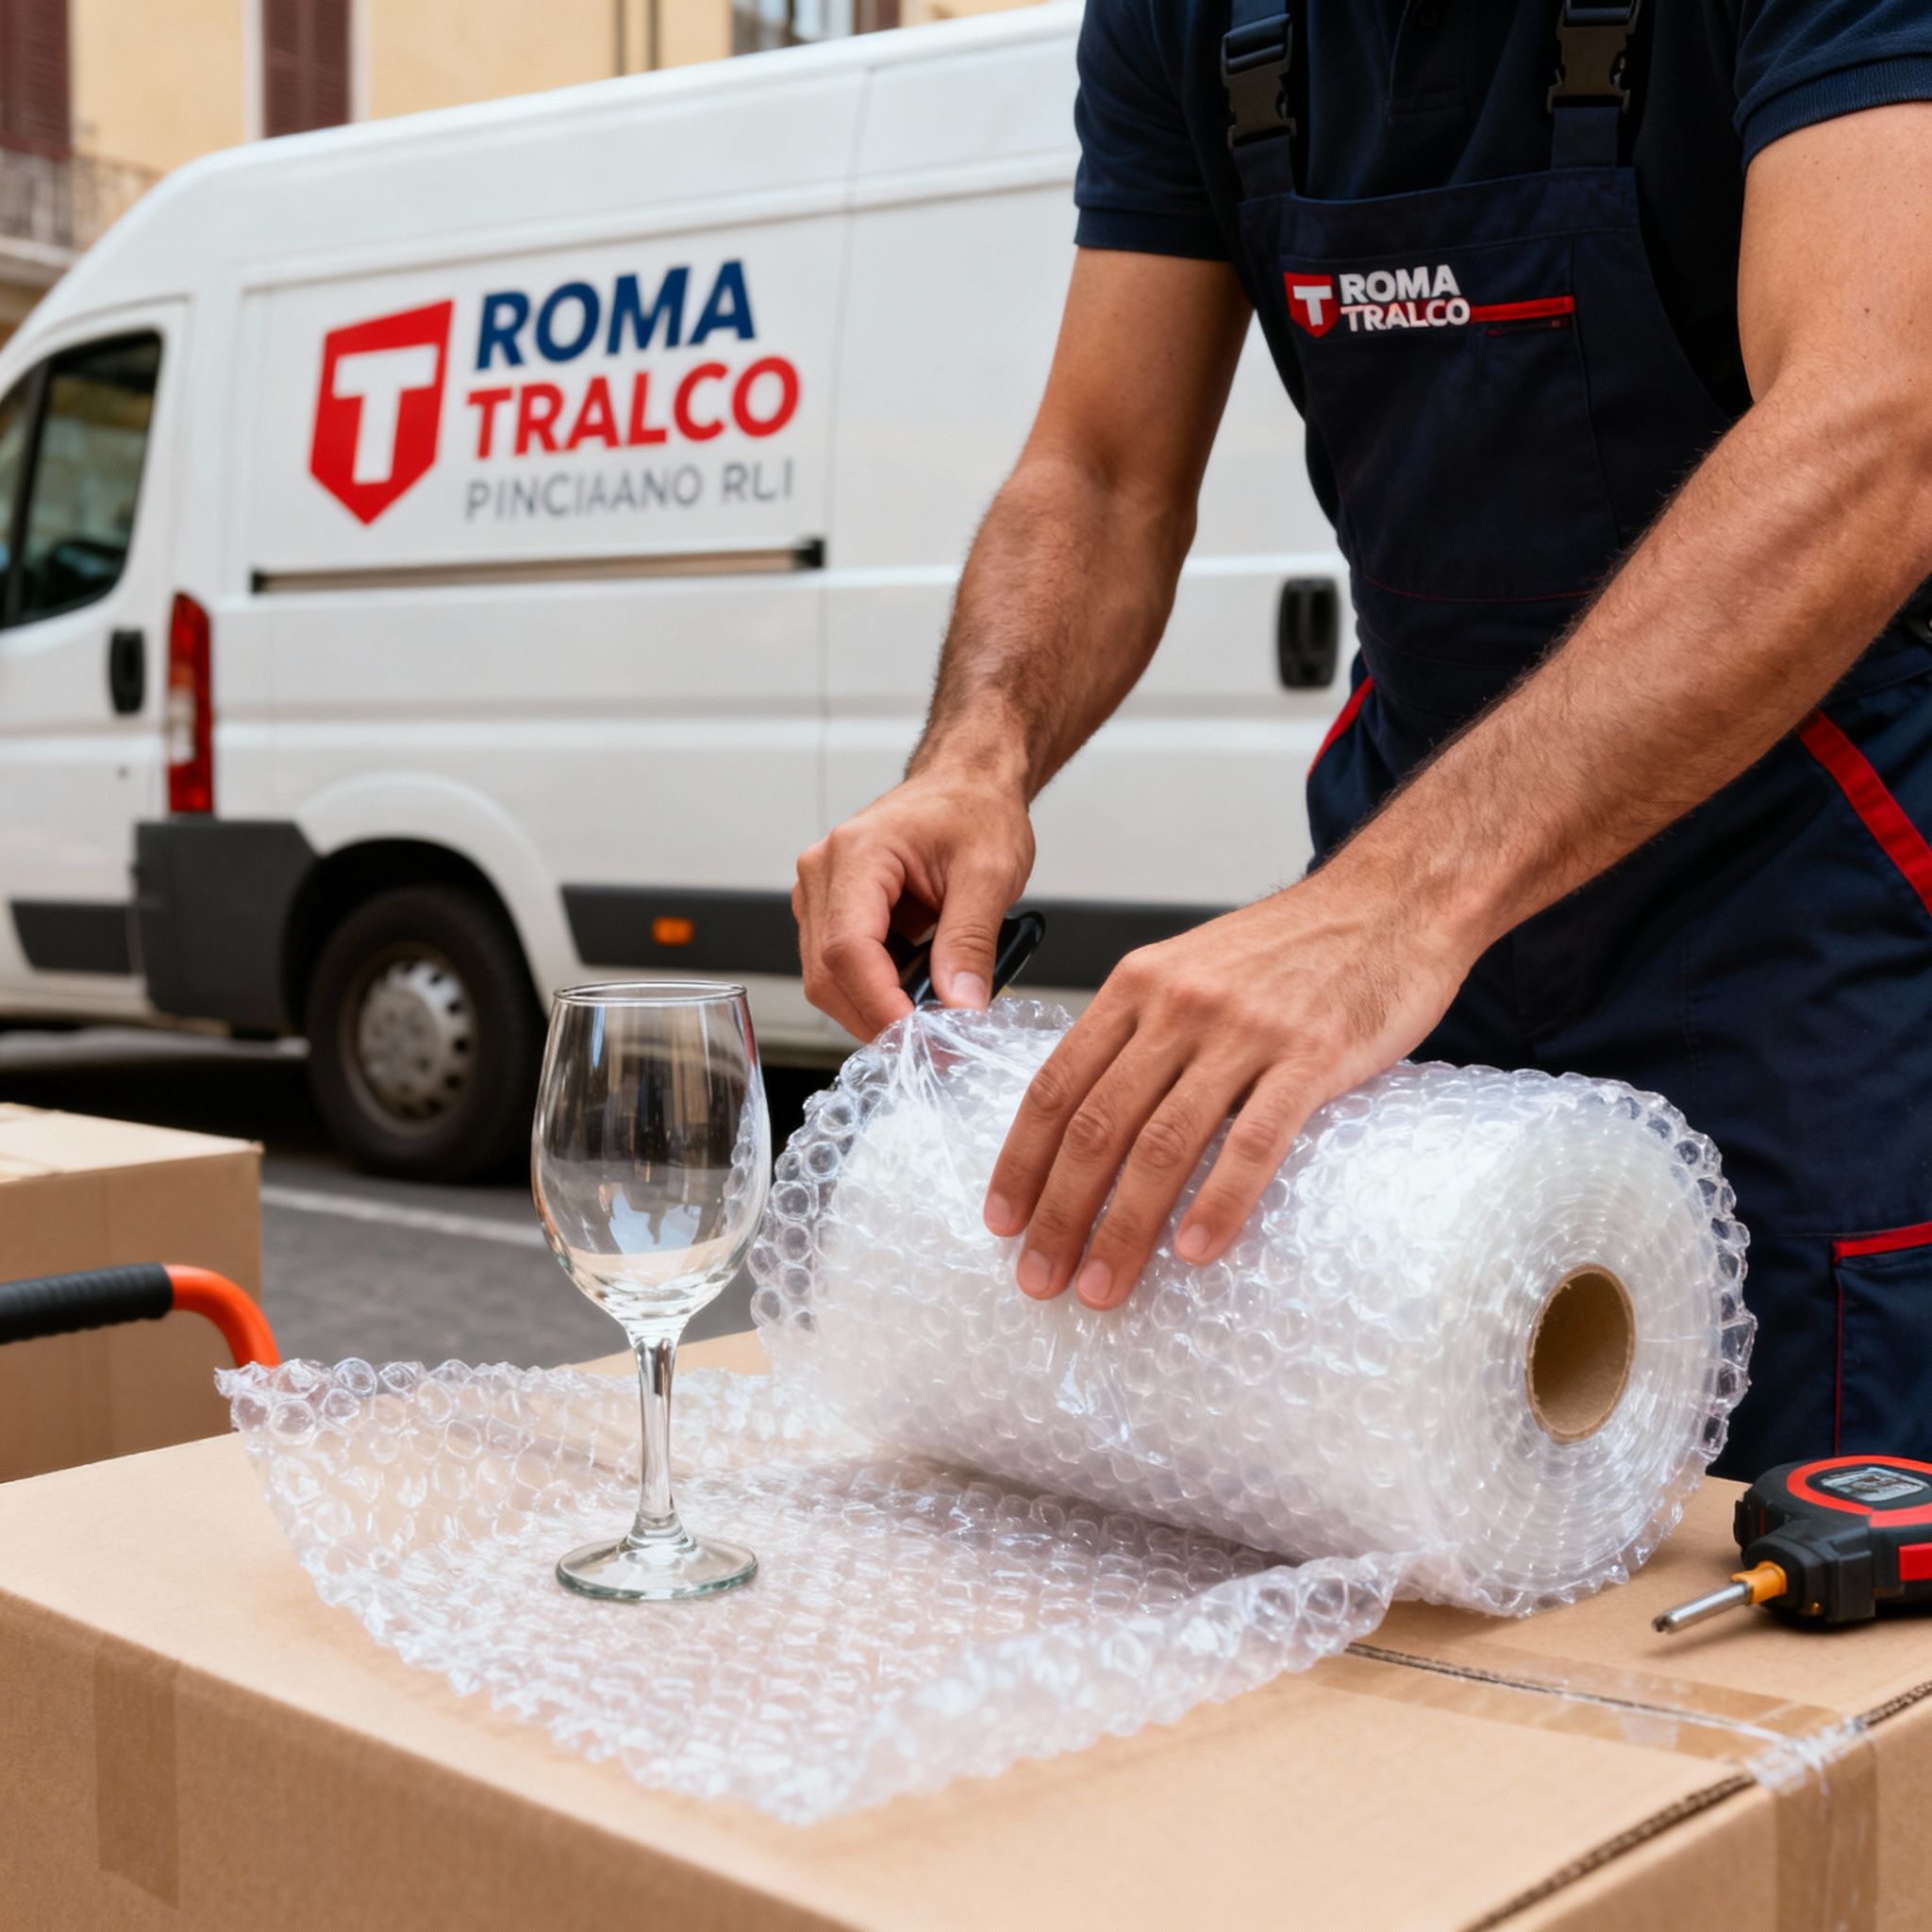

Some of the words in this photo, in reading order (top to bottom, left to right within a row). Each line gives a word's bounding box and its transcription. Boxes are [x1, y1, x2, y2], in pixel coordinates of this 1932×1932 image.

[475, 259, 756, 370] ROMA
[1293, 285, 1333, 325] T
[1339, 265, 1461, 305] ROMA
[1340, 297, 1471, 332] TRALCO
[333, 343, 440, 484] T
[467, 357, 800, 459] TRALCO
